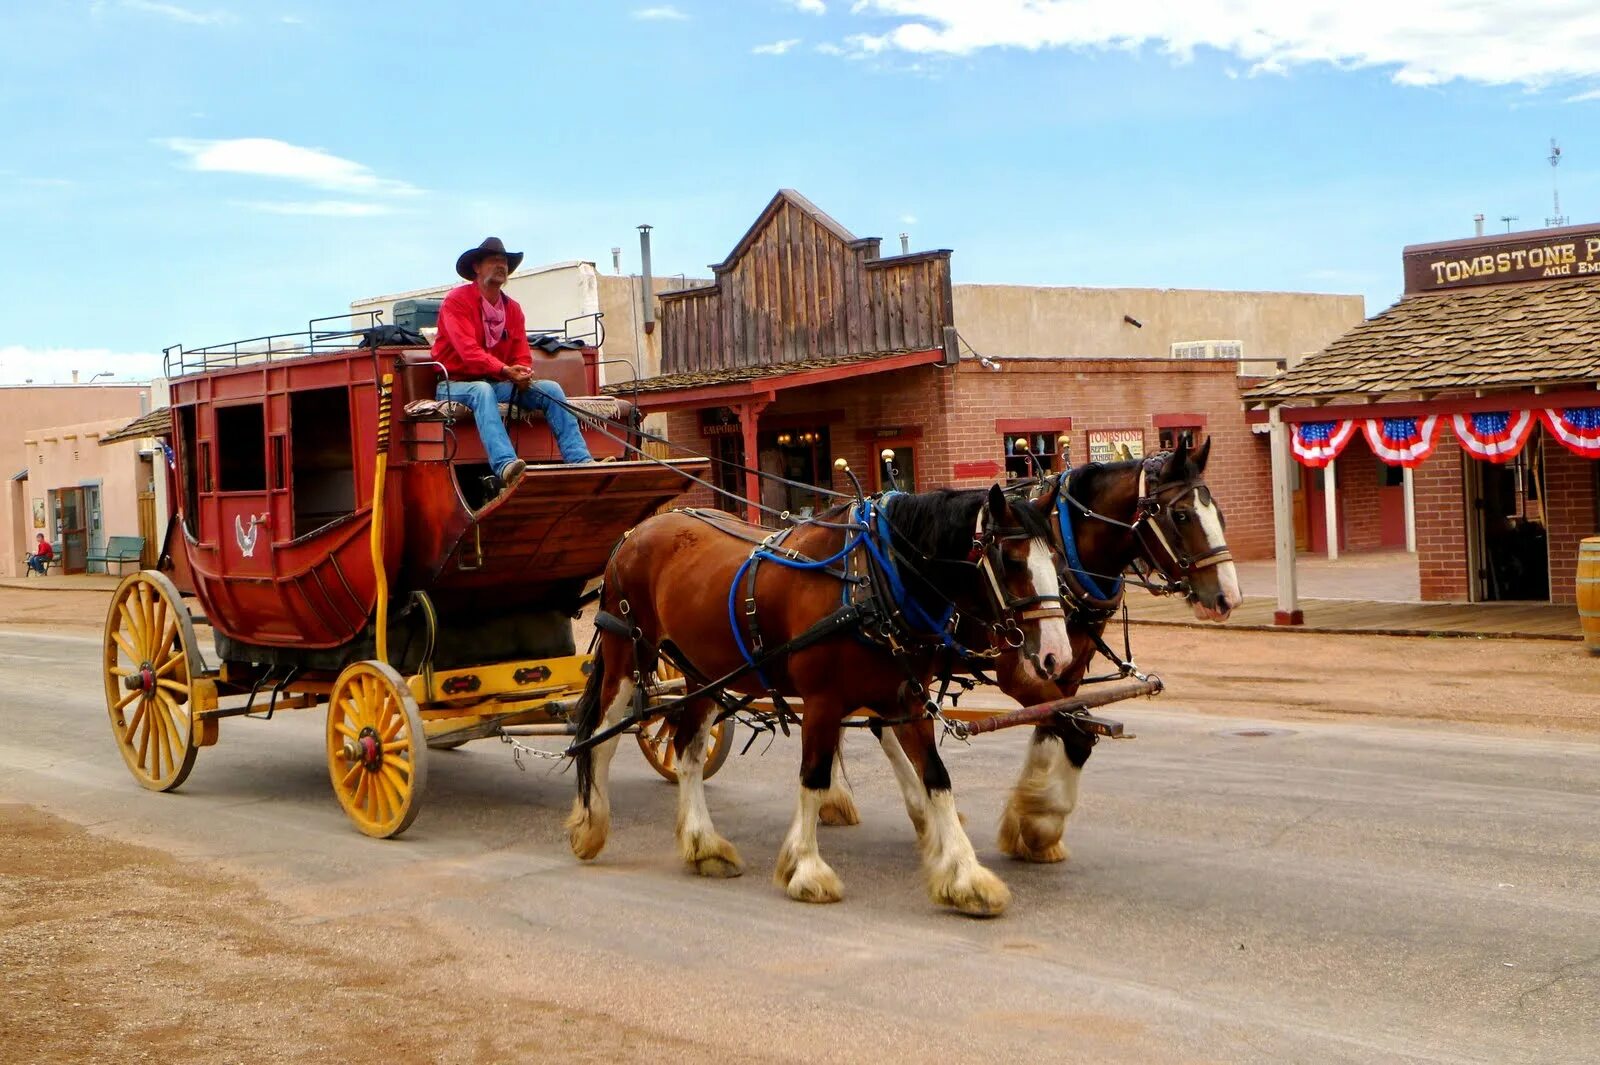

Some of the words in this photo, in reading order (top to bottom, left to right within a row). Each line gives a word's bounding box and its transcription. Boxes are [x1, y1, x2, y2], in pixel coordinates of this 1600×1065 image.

[1431, 244, 1576, 285] TOMBSTONE
[1578, 262, 1600, 273] EM
[703, 424, 742, 435] EMPORIU
[1090, 430, 1142, 443] TOMBSTONE
[1091, 454, 1114, 462] EXHIBIT
